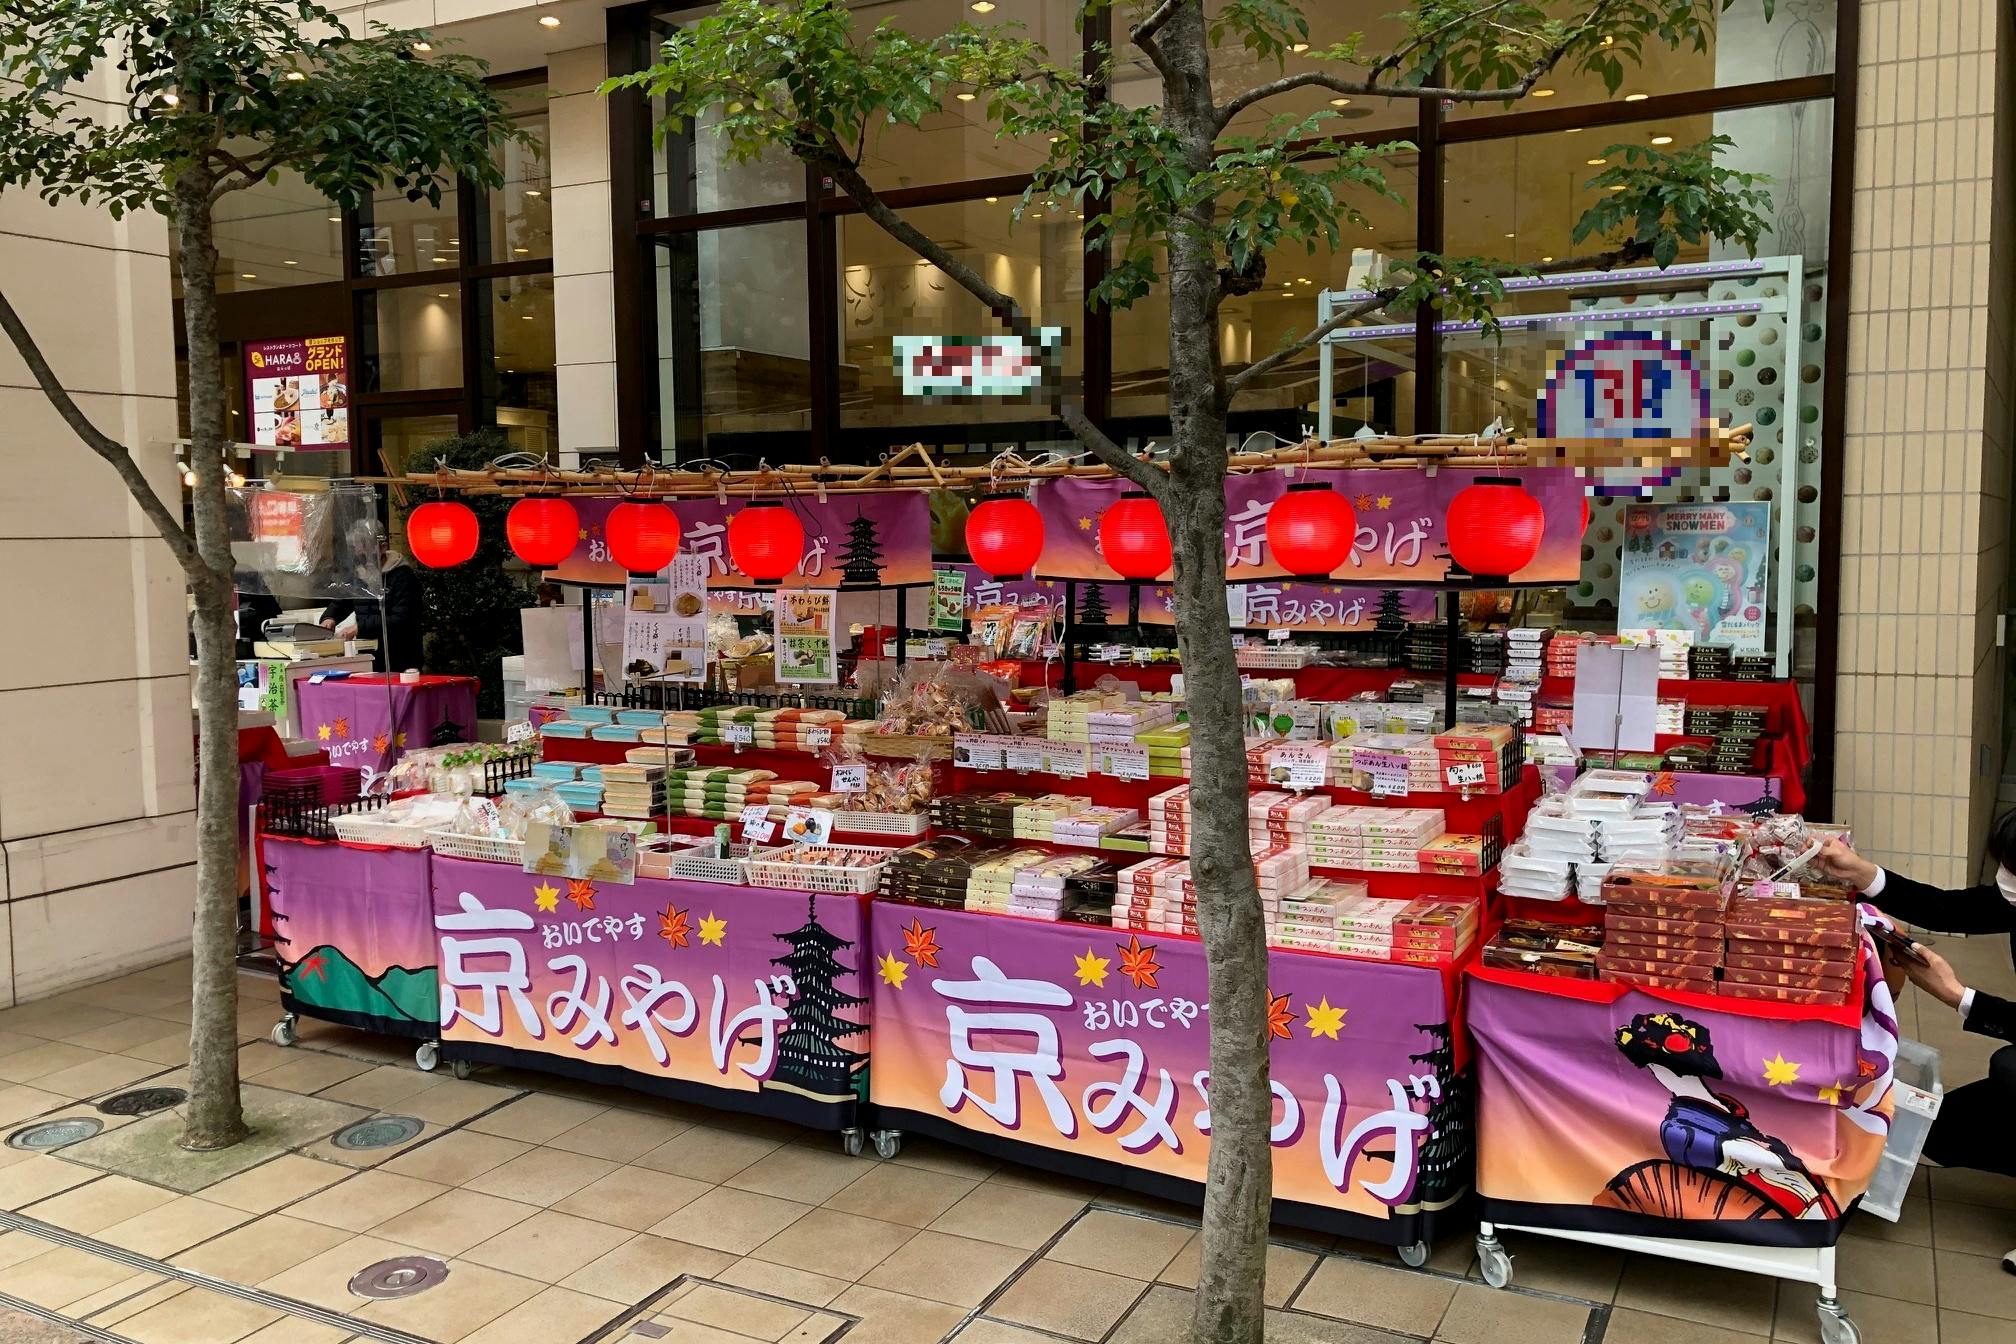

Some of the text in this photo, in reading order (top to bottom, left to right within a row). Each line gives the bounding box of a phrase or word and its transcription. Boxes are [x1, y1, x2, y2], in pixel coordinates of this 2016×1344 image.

[305, 357, 344, 372] OPEN!
[307, 345, 342, 360] グランド
[1666, 511, 1725, 521] MERRY MANY
[1666, 520, 1725, 531] SNOWMEN
[1247, 584, 1366, 626] 京みやげ
[268, 664, 279, 712] 宇治茶
[542, 912, 647, 950] おいでやす
[434, 891, 796, 1078] 京みやげ
